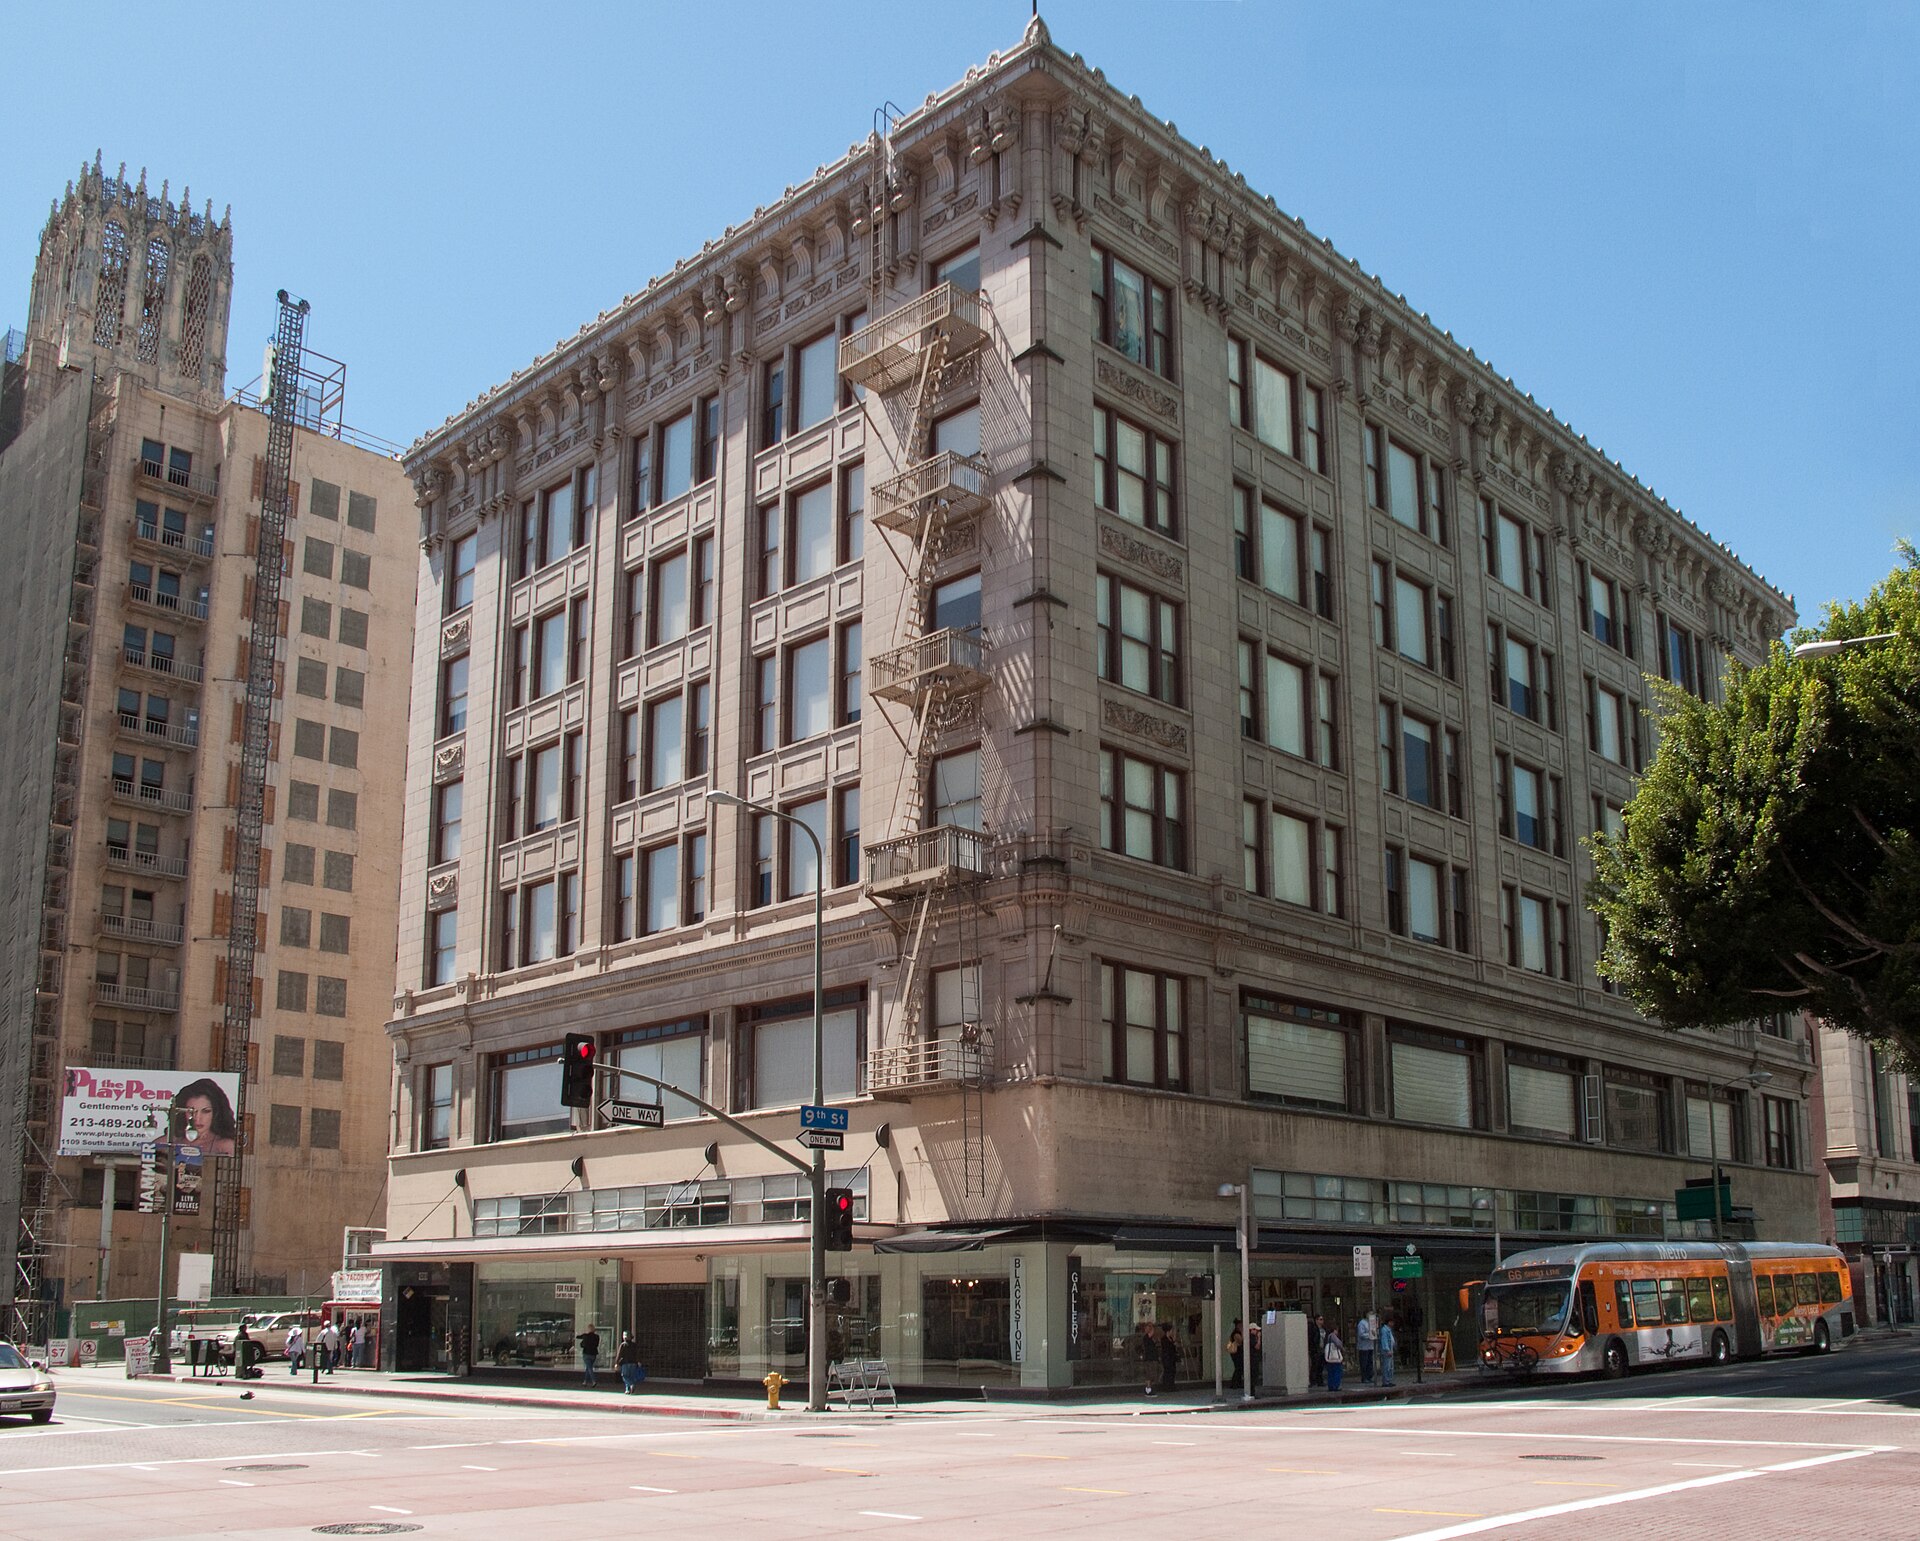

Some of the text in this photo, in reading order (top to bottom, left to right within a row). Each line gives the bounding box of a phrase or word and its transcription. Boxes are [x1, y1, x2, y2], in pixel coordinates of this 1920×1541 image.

[102, 1080, 124, 1088] the
[79, 1102, 139, 1111] Gentlemen's
[612, 1106, 658, 1121] ONE WAY
[805, 1110, 844, 1125] 9th St
[810, 1135, 839, 1145] ONE WAY
[139, 1143, 156, 1213] HAMMER
[1656, 1245, 1688, 1260] Metro
[1508, 1270, 1523, 1281] 66
[1014, 1258, 1022, 1361] BLACKSTONE
[1071, 1272, 1079, 1344] GALLERY
[51, 1348, 66, 1357] $7
